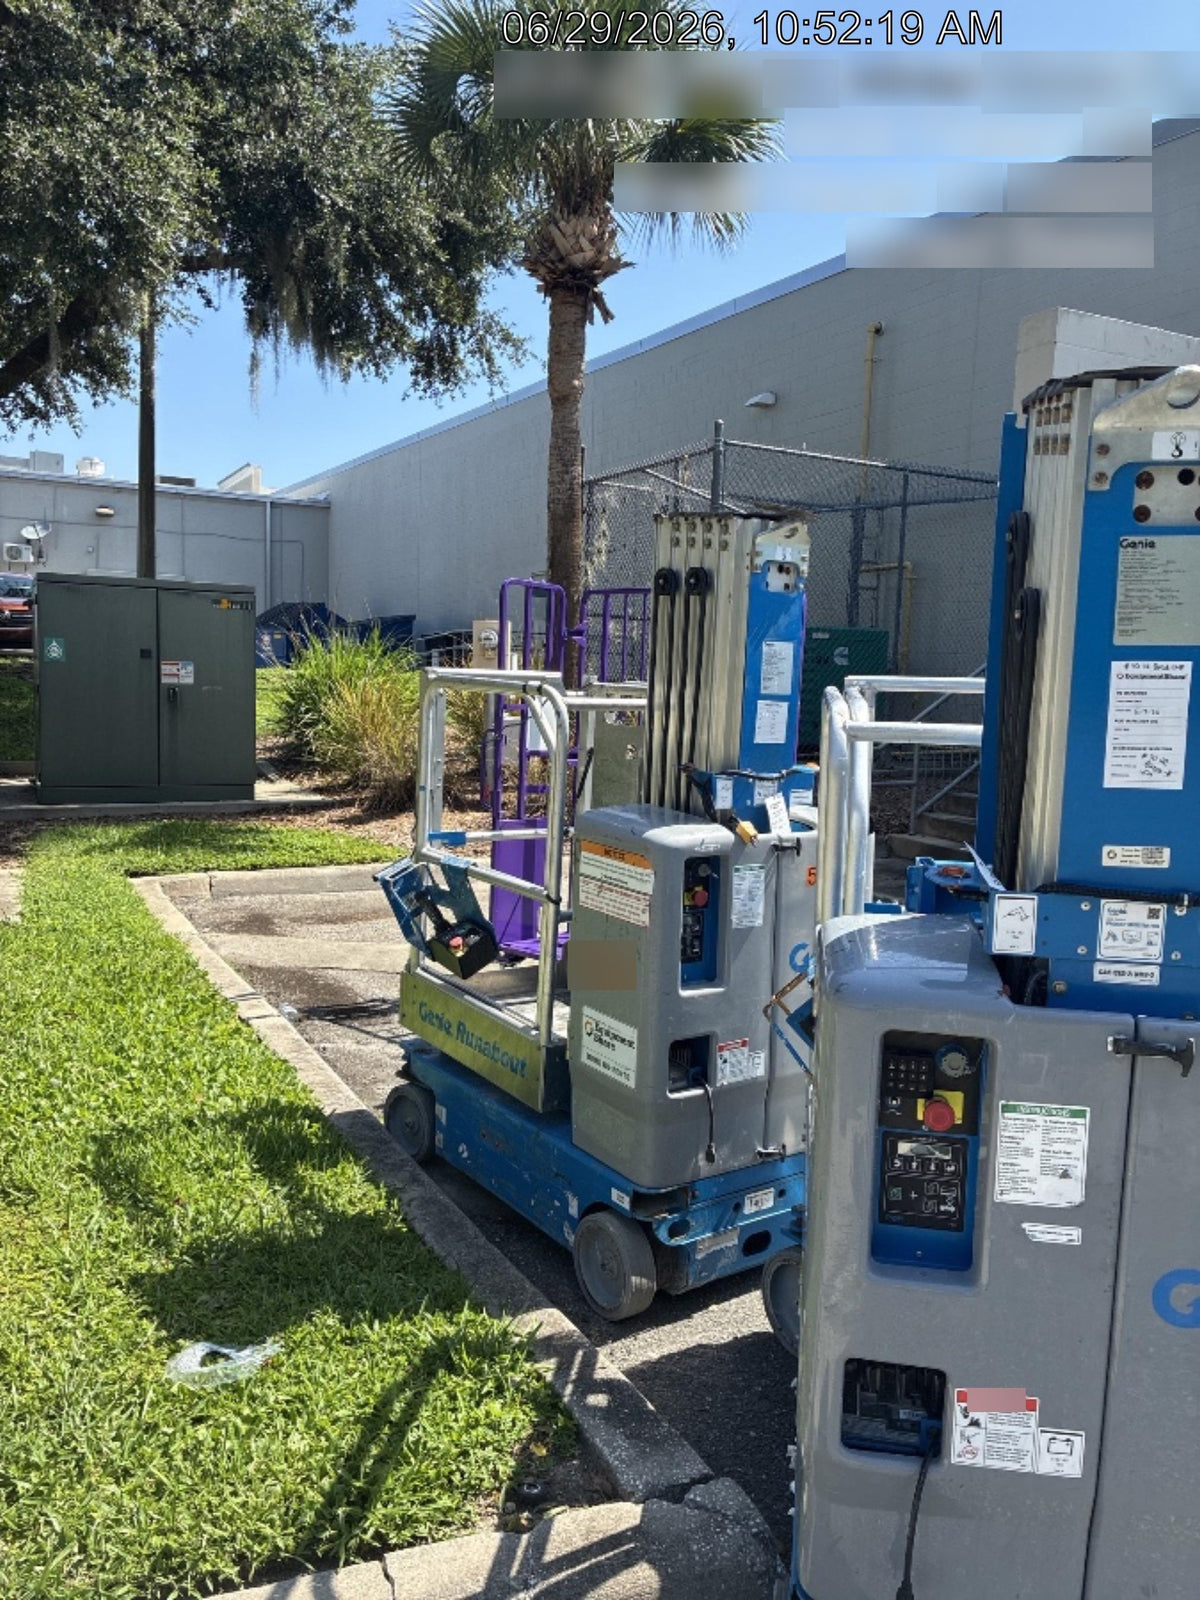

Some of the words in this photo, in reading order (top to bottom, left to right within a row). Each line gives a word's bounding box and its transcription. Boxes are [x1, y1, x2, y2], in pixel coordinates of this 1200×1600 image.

[1120, 538, 1156, 549] Genie
[807, 866, 817, 886] 5
[418, 1001, 452, 1036] Genie
[456, 1019, 527, 1078] Runabout
